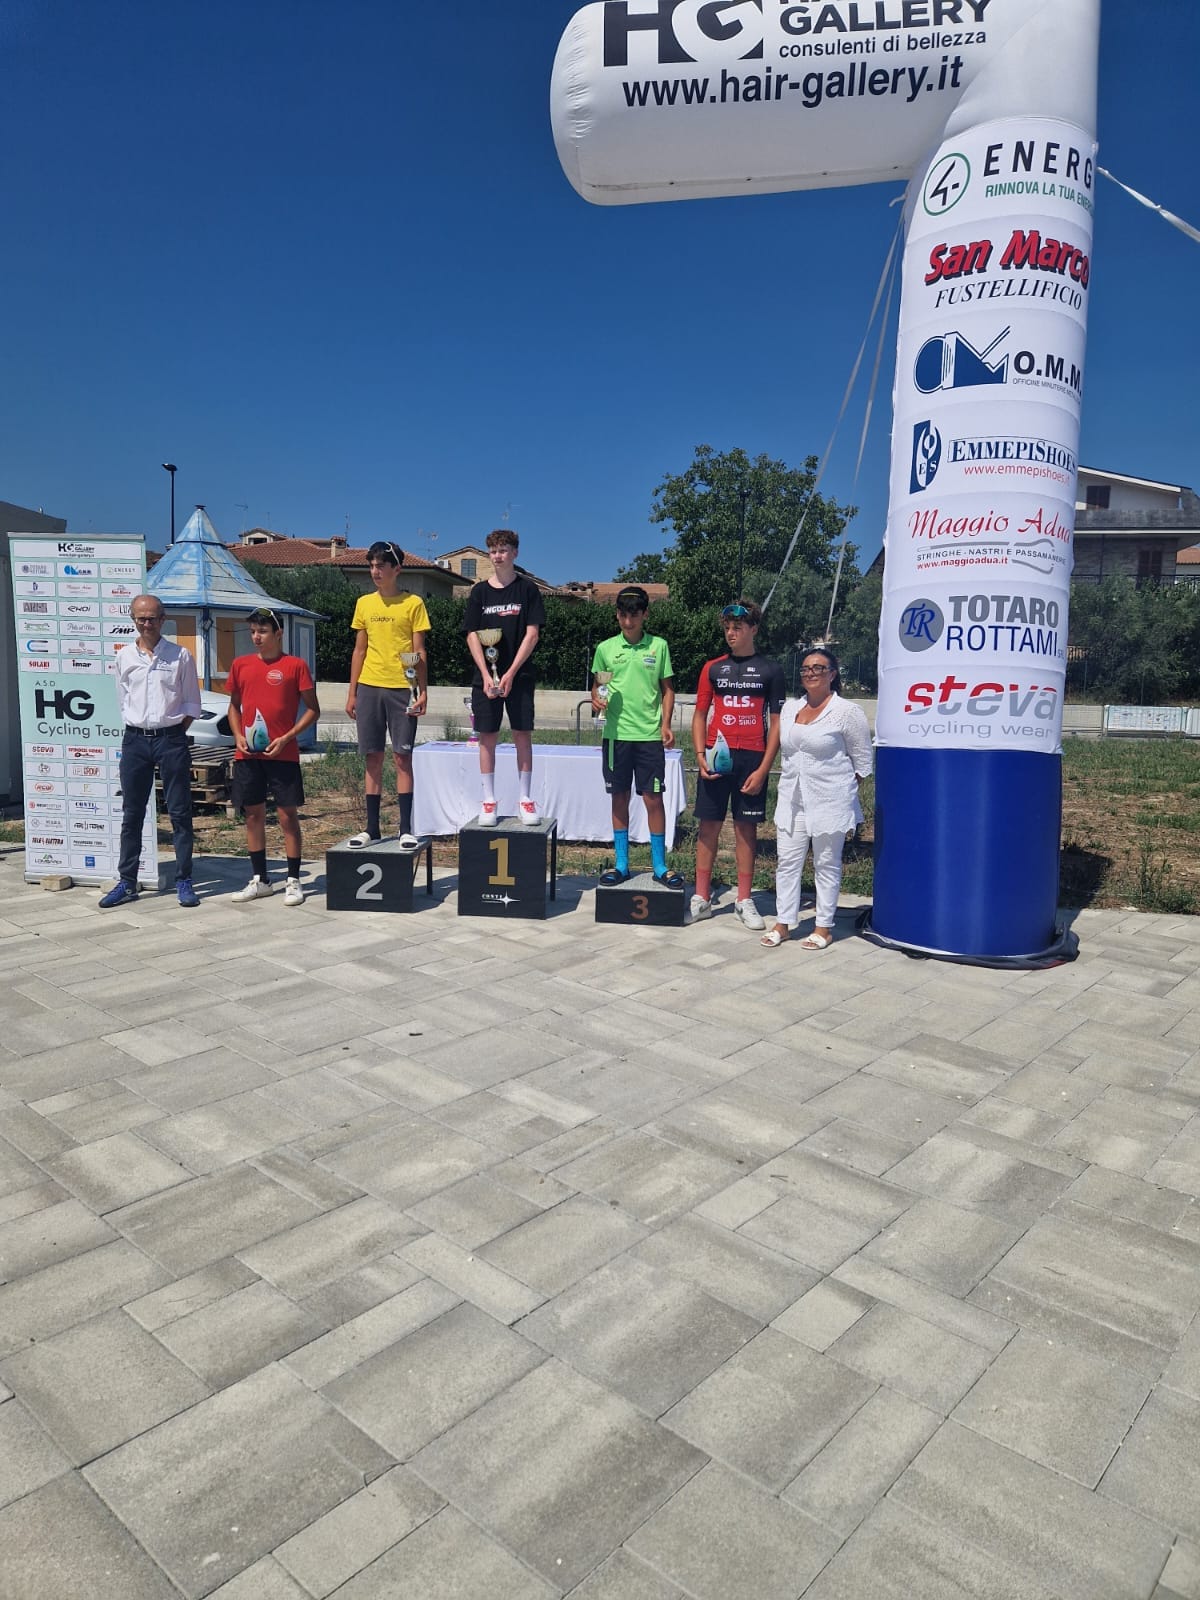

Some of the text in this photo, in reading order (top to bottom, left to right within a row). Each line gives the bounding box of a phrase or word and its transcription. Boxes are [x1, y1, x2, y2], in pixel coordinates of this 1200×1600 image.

[780, 0, 990, 36] GALLERY
[779, 30, 987, 58] consulenti di bellezza
[623, 55, 964, 108] www.hair-gallery.it
[985, 181, 1040, 198] RINNOVA
[1042, 182, 1056, 197] LA
[1059, 184, 1076, 202] TUA
[925, 229, 1090, 290] San Marco
[935, 278, 1083, 310] FUSTELLIFICIO
[1013, 350, 1082, 397] O.M.M.
[1013, 377, 1041, 387] OFFICINE
[964, 465, 1070, 485] www.emmepishoes.it
[908, 507, 1071, 544] Maggio Adua
[917, 550, 962, 562] STRINGHE
[968, 548, 1003, 556] NASTRI
[917, 556, 1009, 570] www.maggioadua.it
[949, 594, 1060, 629] TOTARO
[946, 625, 1058, 656] ROTTAMI
[35, 688, 95, 721] HG
[723, 694, 755, 708] GLS.
[904, 675, 1058, 720] steva
[37, 721, 91, 738] Cycling
[908, 721, 1051, 738] cycling wear
[488, 838, 516, 886] 1
[355, 862, 384, 901] 2
[630, 895, 649, 920] 3
